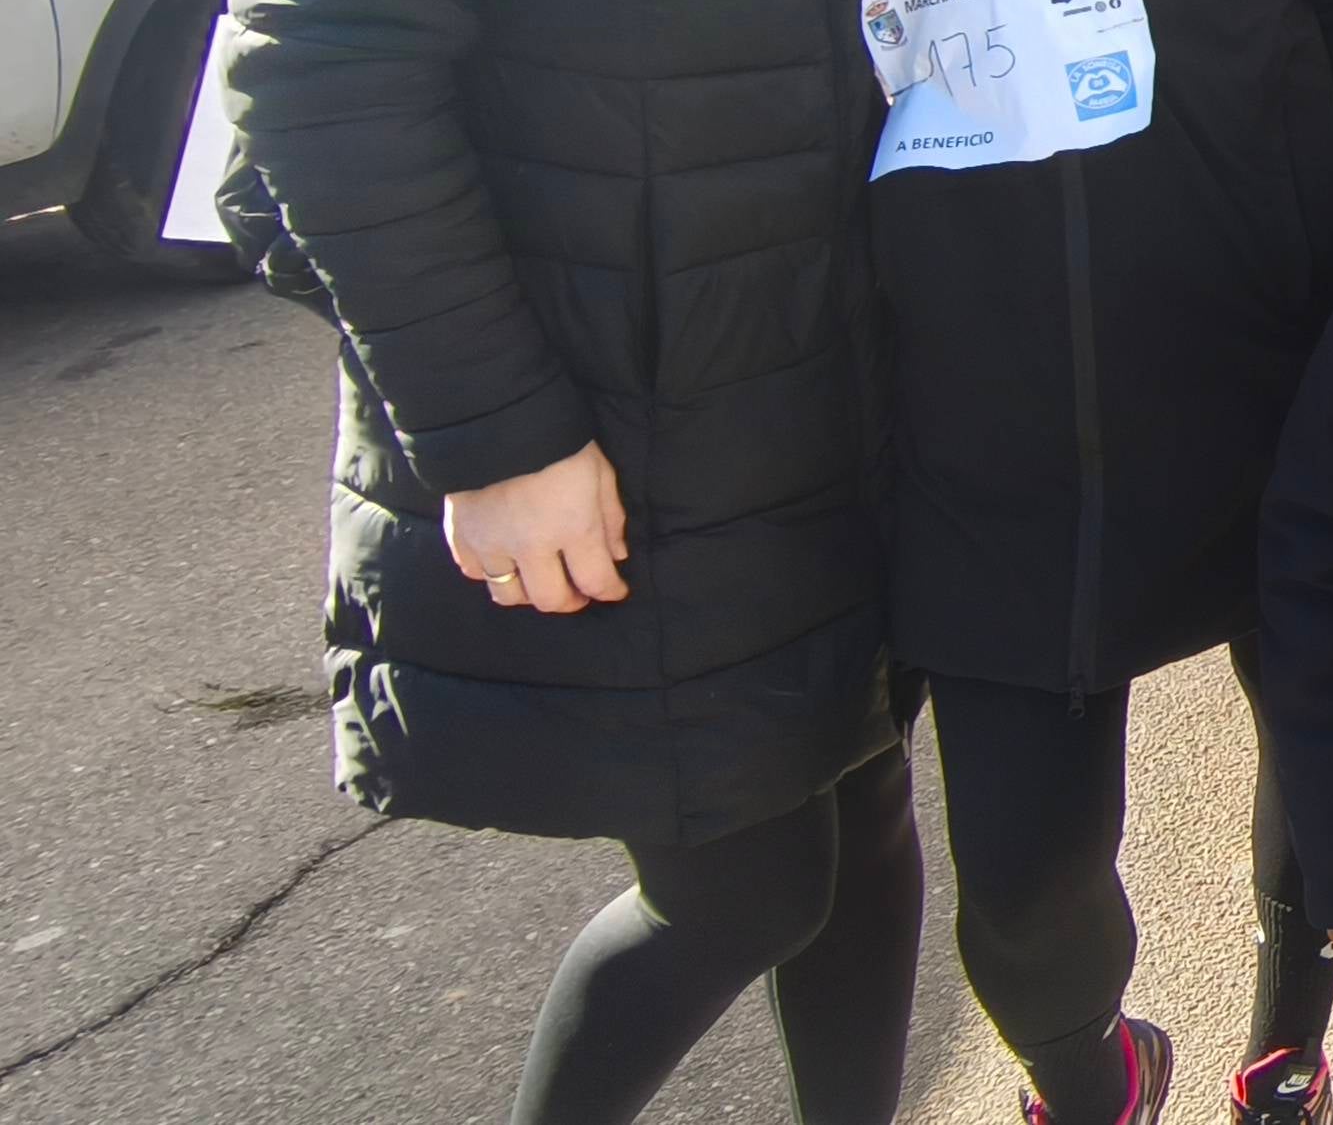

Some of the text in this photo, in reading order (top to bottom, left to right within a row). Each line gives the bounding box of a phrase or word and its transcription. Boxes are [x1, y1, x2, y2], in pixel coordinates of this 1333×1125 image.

[889, 23, 1016, 97] 175
[896, 131, 994, 152] A BENEFICIO
